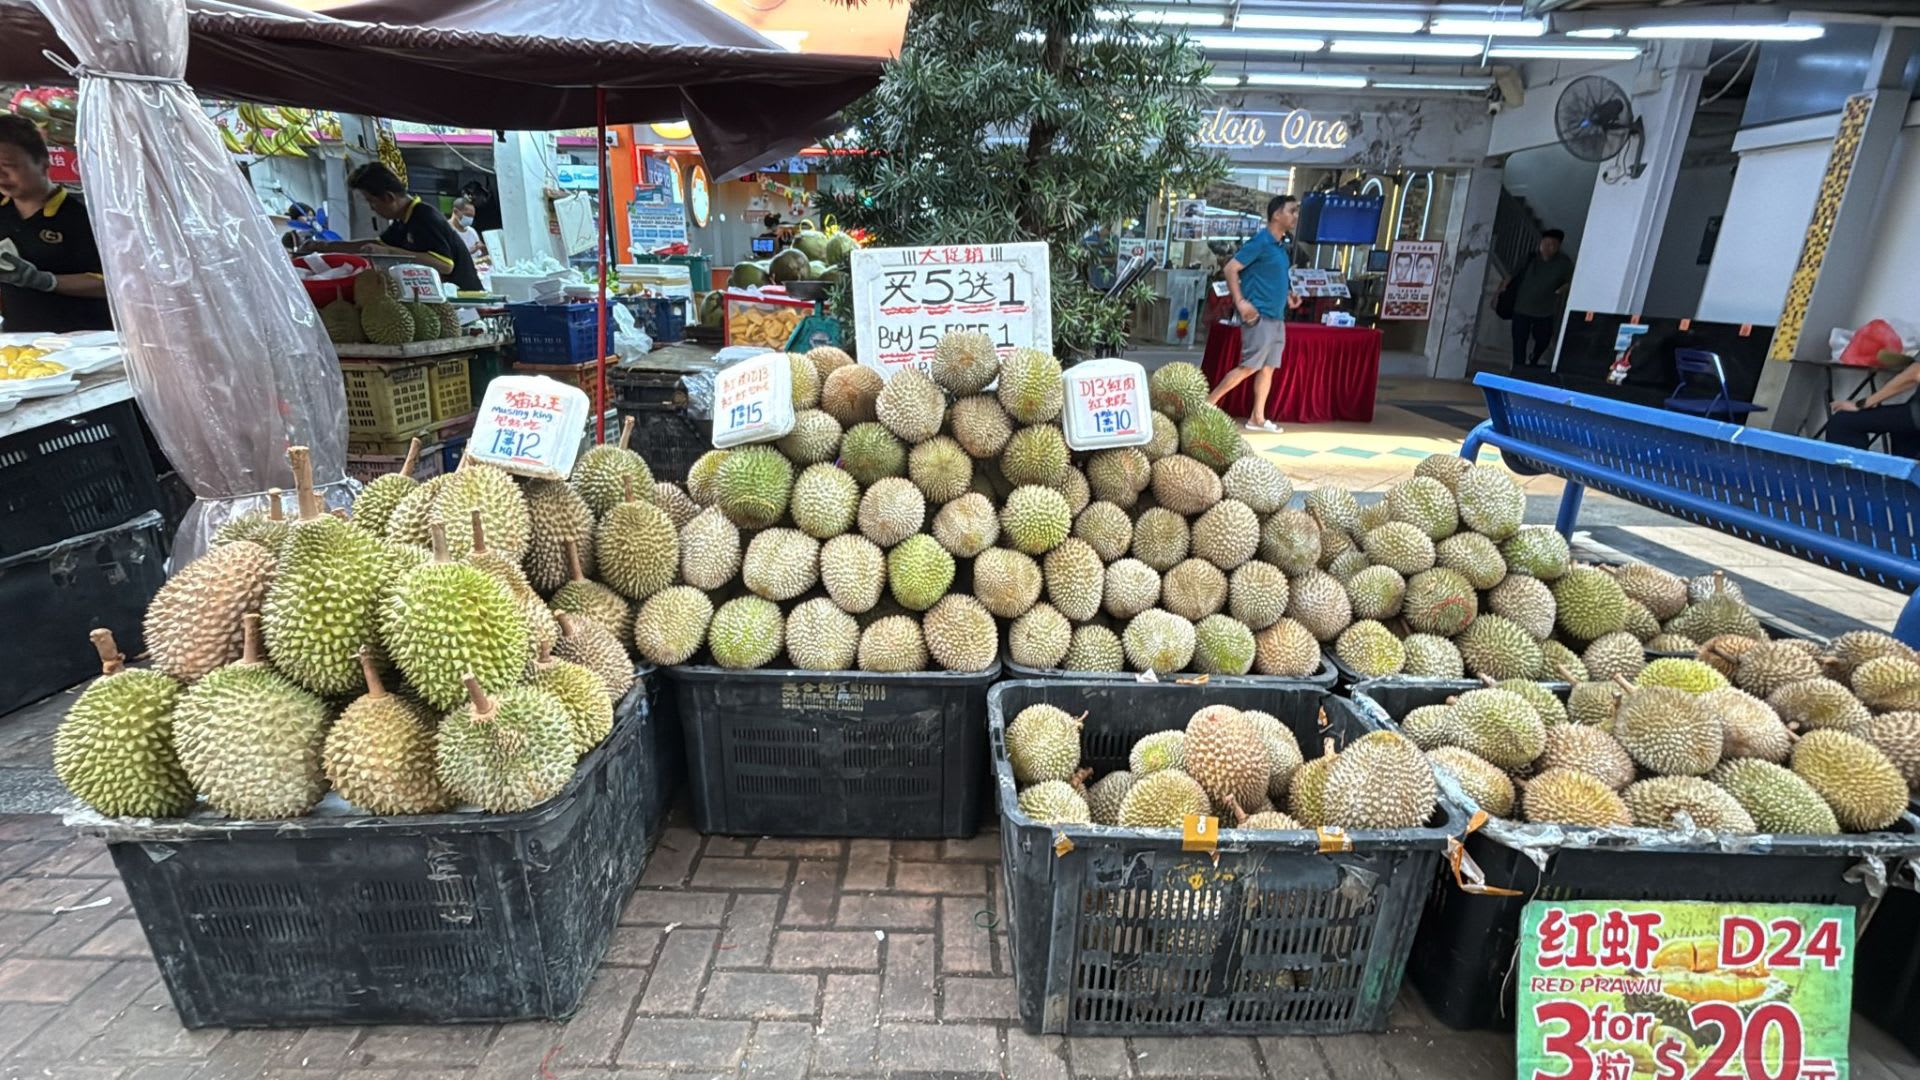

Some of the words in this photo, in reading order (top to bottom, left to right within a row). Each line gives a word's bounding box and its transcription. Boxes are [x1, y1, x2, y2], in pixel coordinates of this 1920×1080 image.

[1280, 108, 1349, 149] One
[919, 325, 939, 349] 5
[997, 323, 1015, 348] 1
[1537, 910, 1662, 968] 红虾
[1721, 917, 1842, 967] D24
[1531, 977, 1575, 993] RED
[1579, 976, 1662, 994] PRAWN
[1592, 1004, 1652, 1041] for
[1596, 1051, 1631, 1080] 粒
